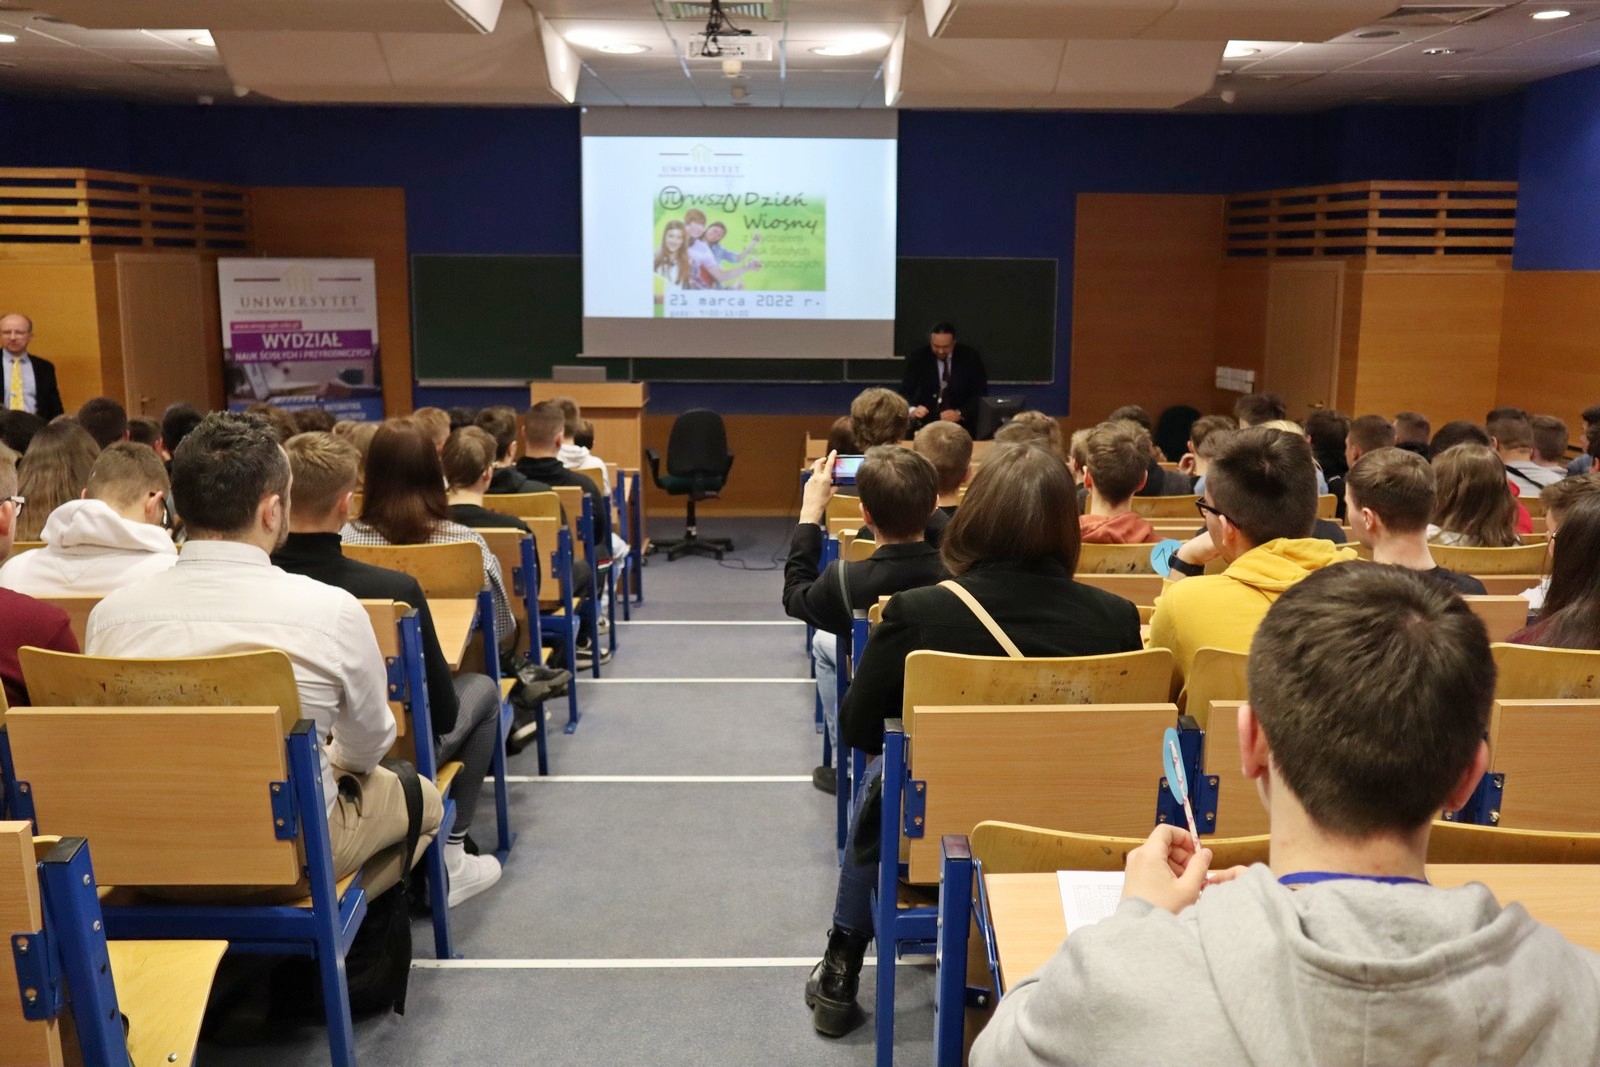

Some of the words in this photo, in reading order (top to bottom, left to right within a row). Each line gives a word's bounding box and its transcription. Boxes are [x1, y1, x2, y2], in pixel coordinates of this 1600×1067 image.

[744, 191, 808, 207] Dzień
[743, 212, 818, 235] Wiosny
[240, 295, 358, 308] UNIWERSYTET
[669, 294, 688, 306] 21
[698, 295, 746, 306] marca
[756, 294, 794, 307] 2022
[261, 332, 343, 349] WYDZIAŁ
[235, 351, 258, 361] NAUK
